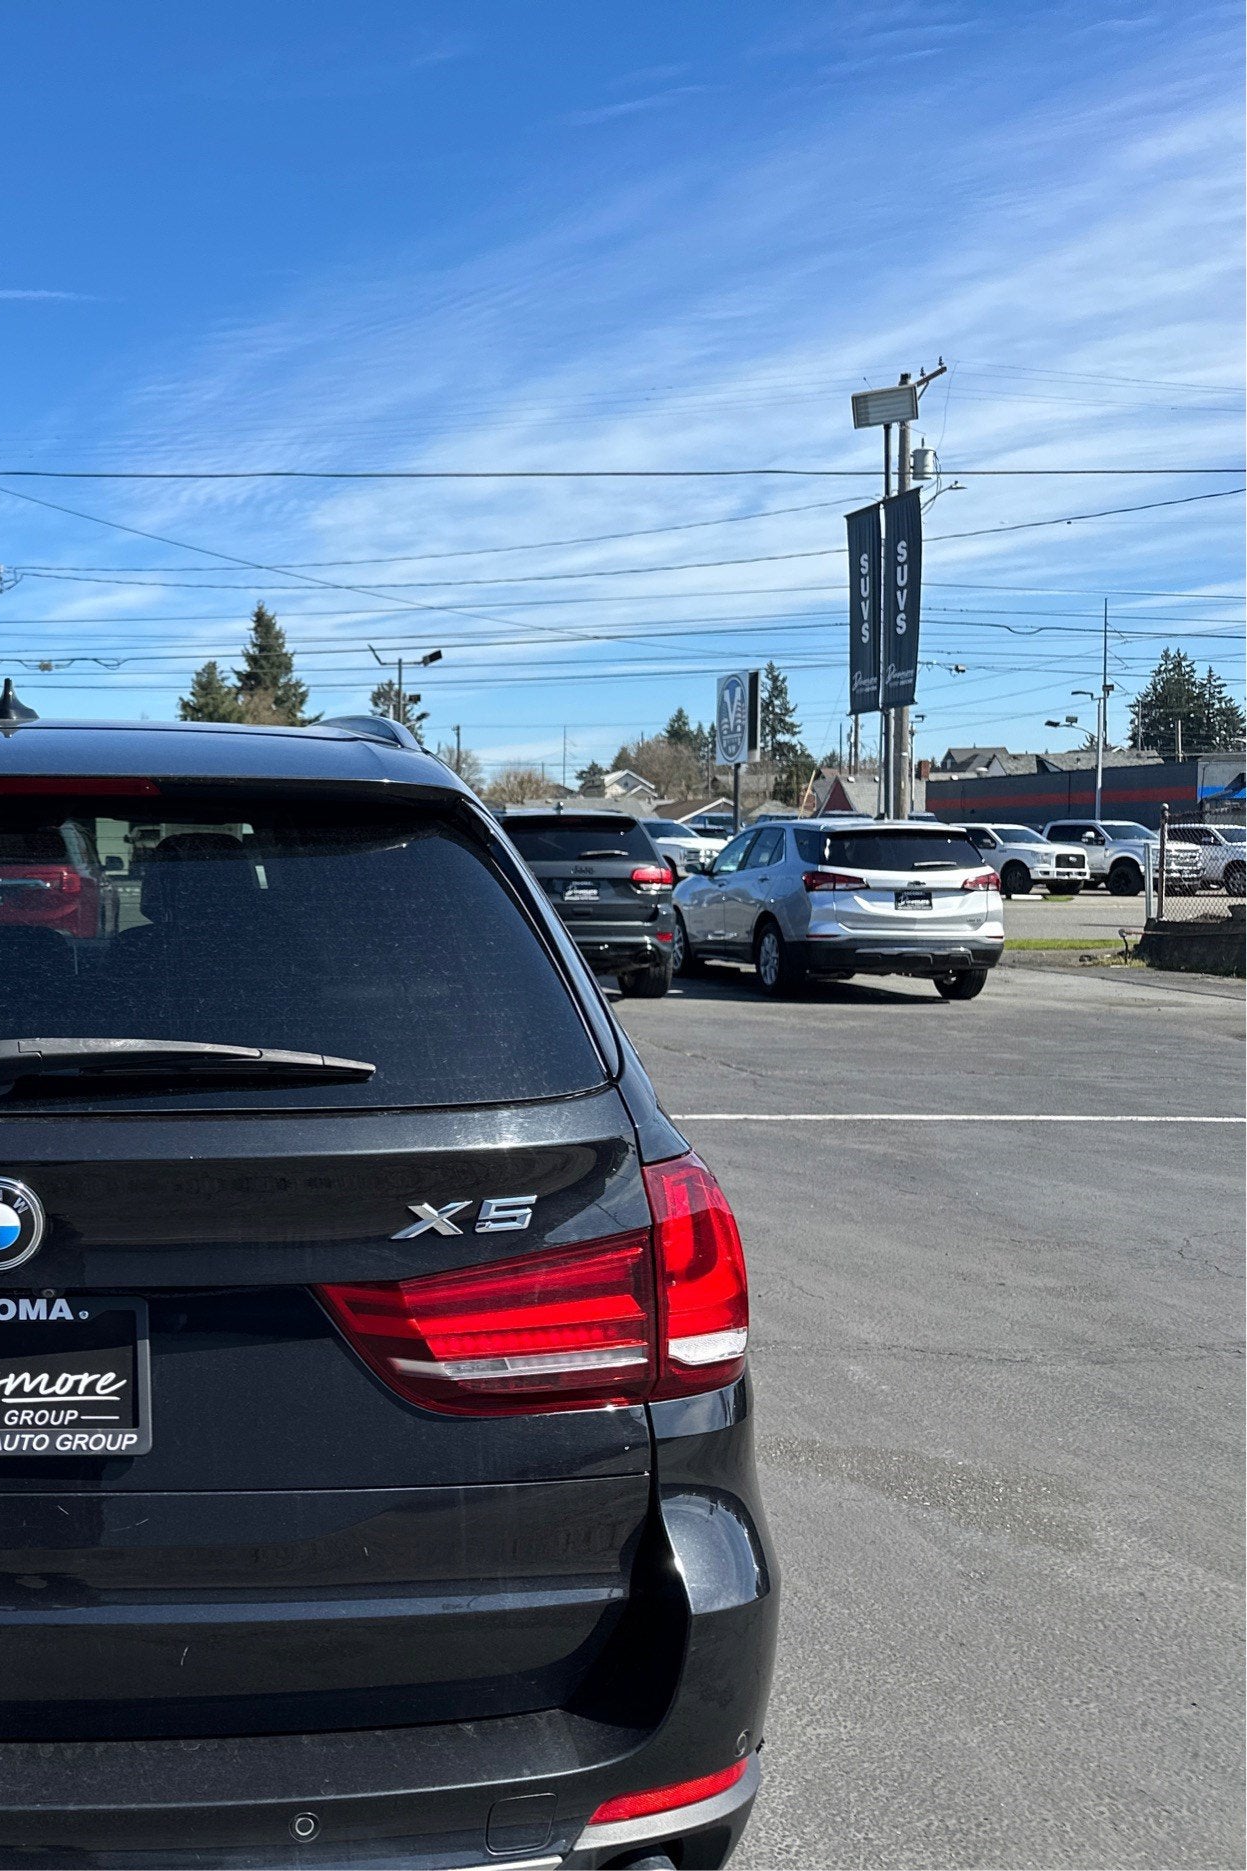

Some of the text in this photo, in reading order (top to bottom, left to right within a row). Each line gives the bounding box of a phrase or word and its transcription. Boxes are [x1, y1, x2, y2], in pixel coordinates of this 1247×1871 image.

[860, 553, 870, 644] SUVS
[895, 540, 908, 636] SUVS
[390, 1194, 538, 1240] X5
[3, 1410, 79, 1426] GROUP
[55, 1434, 138, 1453] GROUP
